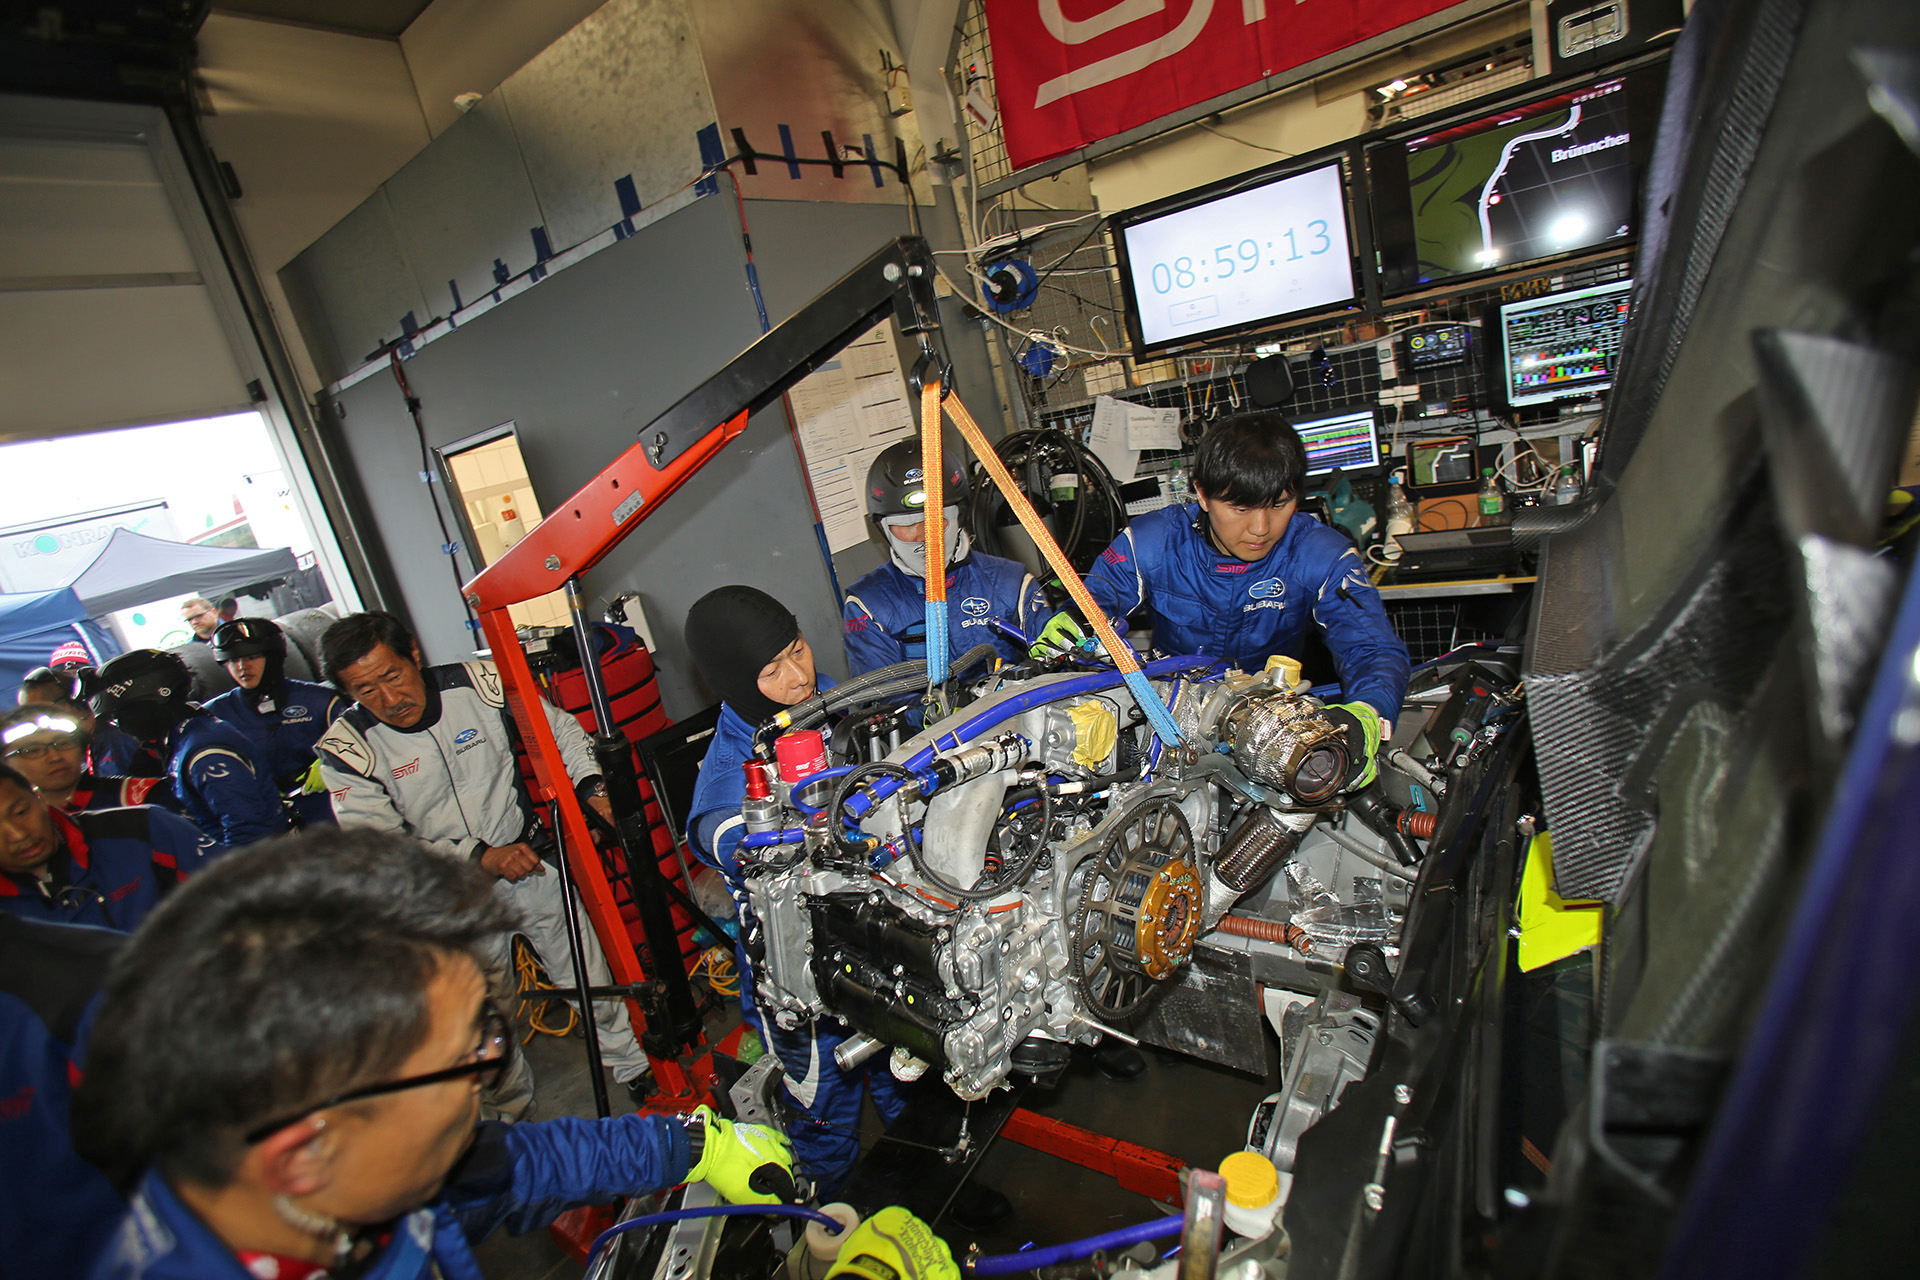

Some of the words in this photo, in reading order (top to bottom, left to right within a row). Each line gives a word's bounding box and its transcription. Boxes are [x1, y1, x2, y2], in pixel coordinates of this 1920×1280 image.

[1151, 218, 1332, 295] 08:59:13
[903, 477, 923, 486] SUBAR
[455, 737, 487, 756] SUBARU
